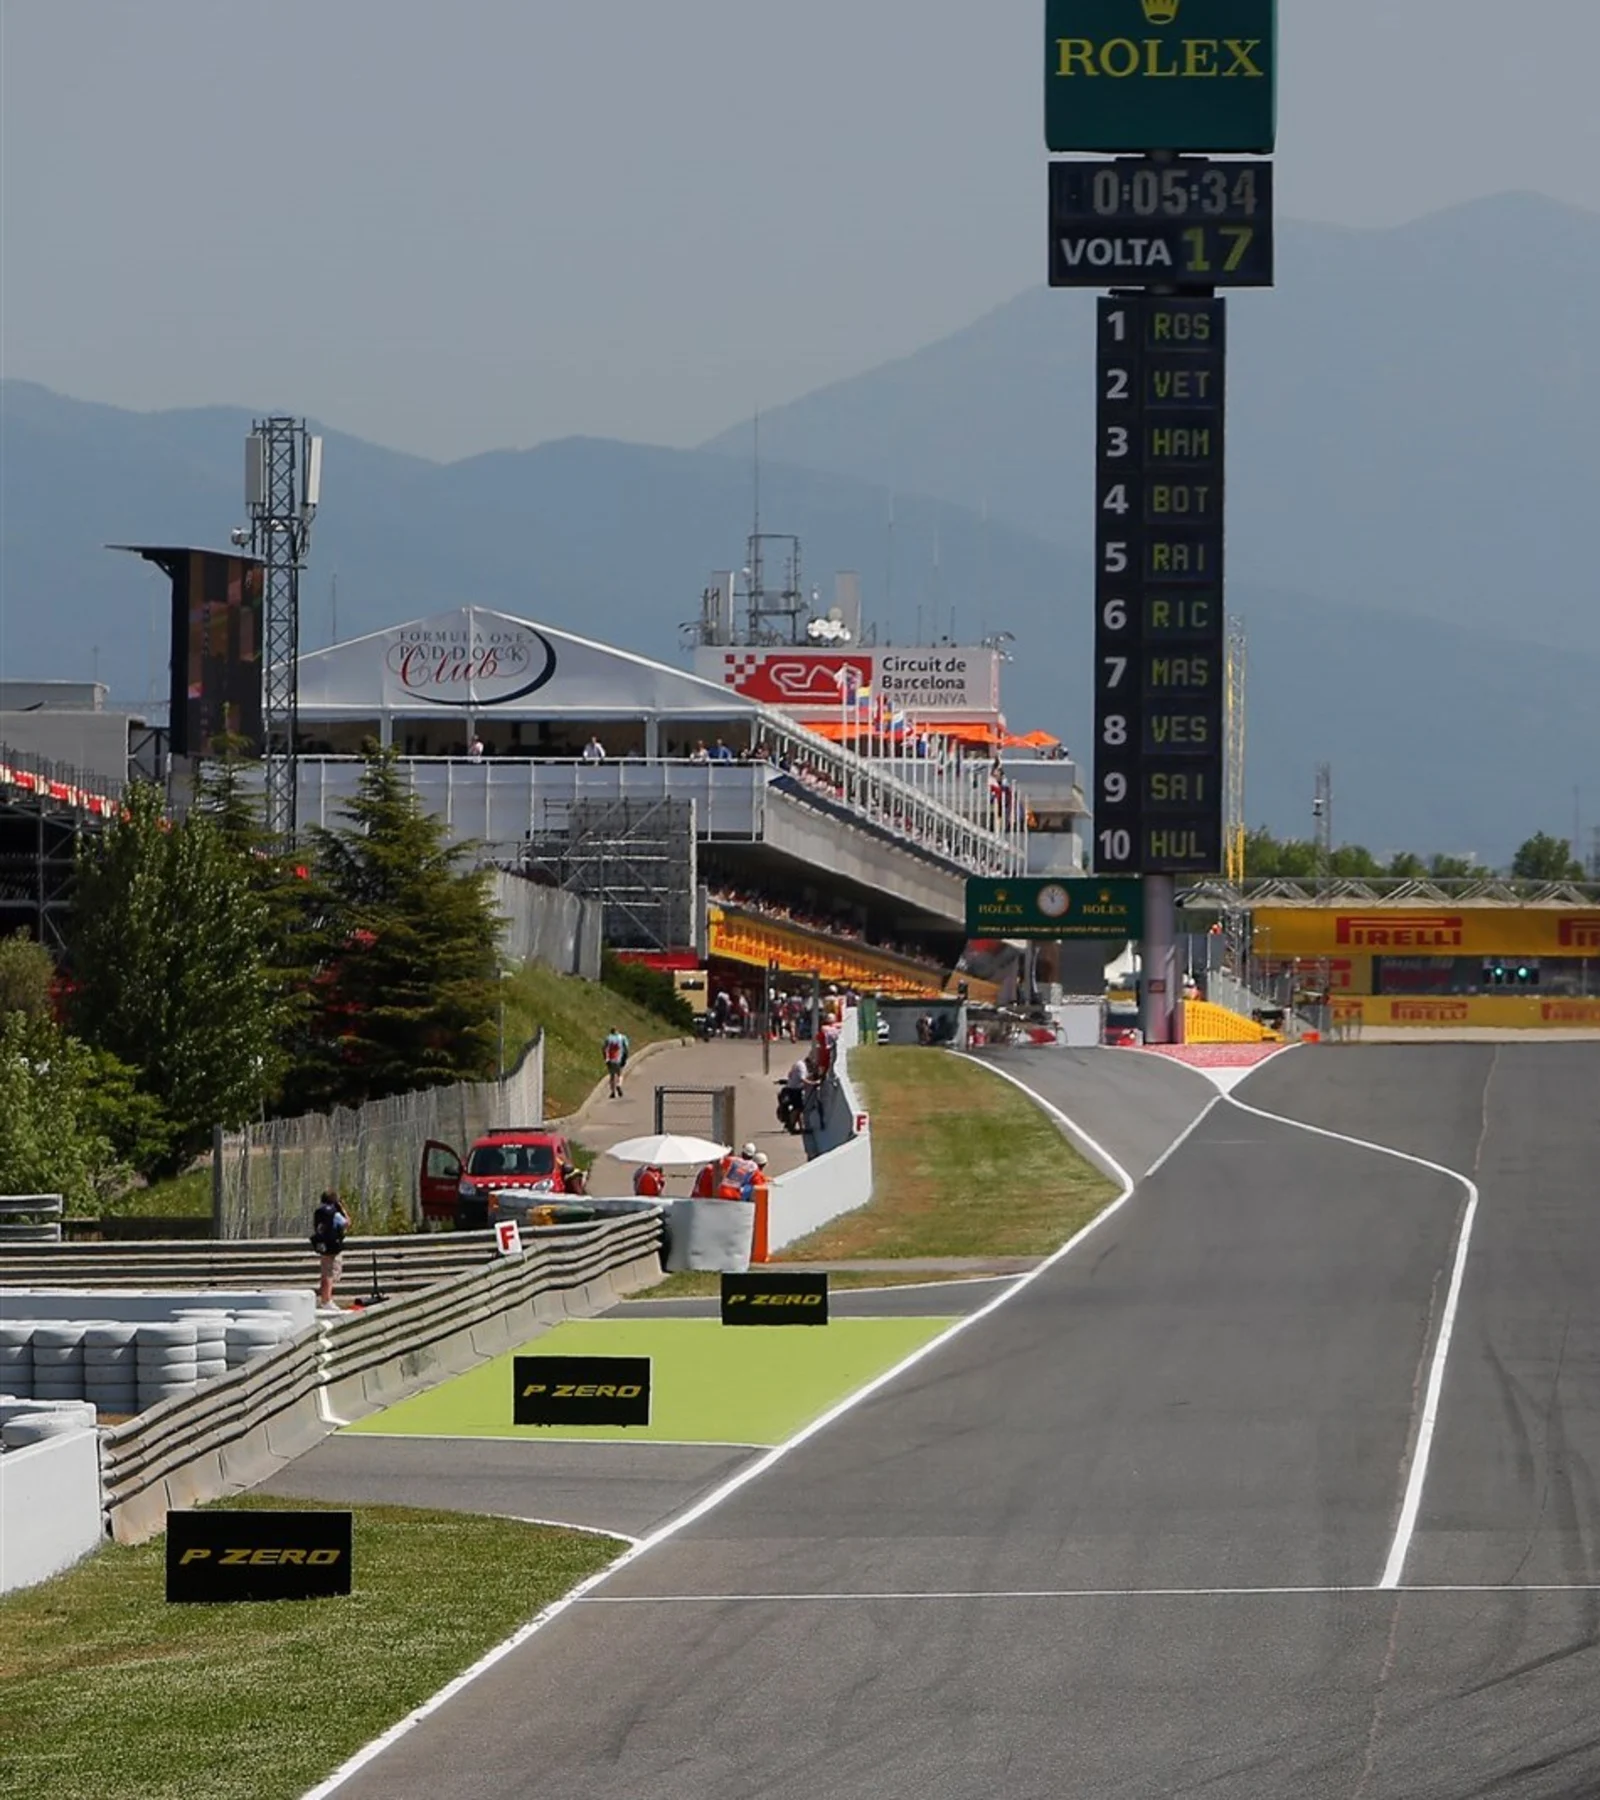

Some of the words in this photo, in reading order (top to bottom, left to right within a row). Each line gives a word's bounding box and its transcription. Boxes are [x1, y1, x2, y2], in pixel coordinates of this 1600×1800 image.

[1055, 38, 1264, 77] ROLEX
[1093, 170, 1257, 215] 0:05:34
[1060, 238, 1173, 266] VOLTA
[1183, 227, 1254, 272] 17
[1107, 311, 1126, 341] 1
[1154, 312, 1210, 340] ROS
[1106, 369, 1129, 399] 2
[1153, 370, 1210, 398] VET
[1106, 426, 1129, 457] 3
[1153, 428, 1210, 456] HAM
[1103, 484, 1129, 514] 4
[1153, 486, 1210, 513] BOT
[1105, 541, 1128, 572] 5
[1153, 544, 1205, 571] RAI
[1103, 599, 1128, 630] 6
[1152, 600, 1208, 627] RIC
[401, 631, 484, 643] FORMULA
[490, 633, 525, 644] ONE
[393, 645, 512, 688] Club
[400, 646, 525, 662] PADDOCK
[882, 656, 942, 672] Circuit
[945, 656, 967, 672] de
[882, 675, 965, 689] Barcelona
[1104, 657, 1128, 688] 7
[1152, 658, 1209, 686] MAS
[889, 693, 967, 705] ATALUNYA
[1103, 714, 1128, 745] 8
[1151, 716, 1208, 742] VES
[1103, 772, 1128, 802] 9
[1150, 774, 1204, 801] SAI
[1099, 829, 1131, 861] 10
[1150, 831, 1207, 858] HUL
[978, 905, 1023, 914] ROLEX
[1082, 905, 1127, 914] ROLEX
[1336, 917, 1463, 945] PIRELLI
[856, 1115, 867, 1132] F
[499, 1225, 514, 1250] F
[727, 1295, 747, 1305] P
[751, 1295, 822, 1306] ZERO
[522, 1385, 546, 1397] P
[551, 1385, 642, 1398] ZERO
[179, 1549, 211, 1565] P
[218, 1549, 341, 1565] ZERO
